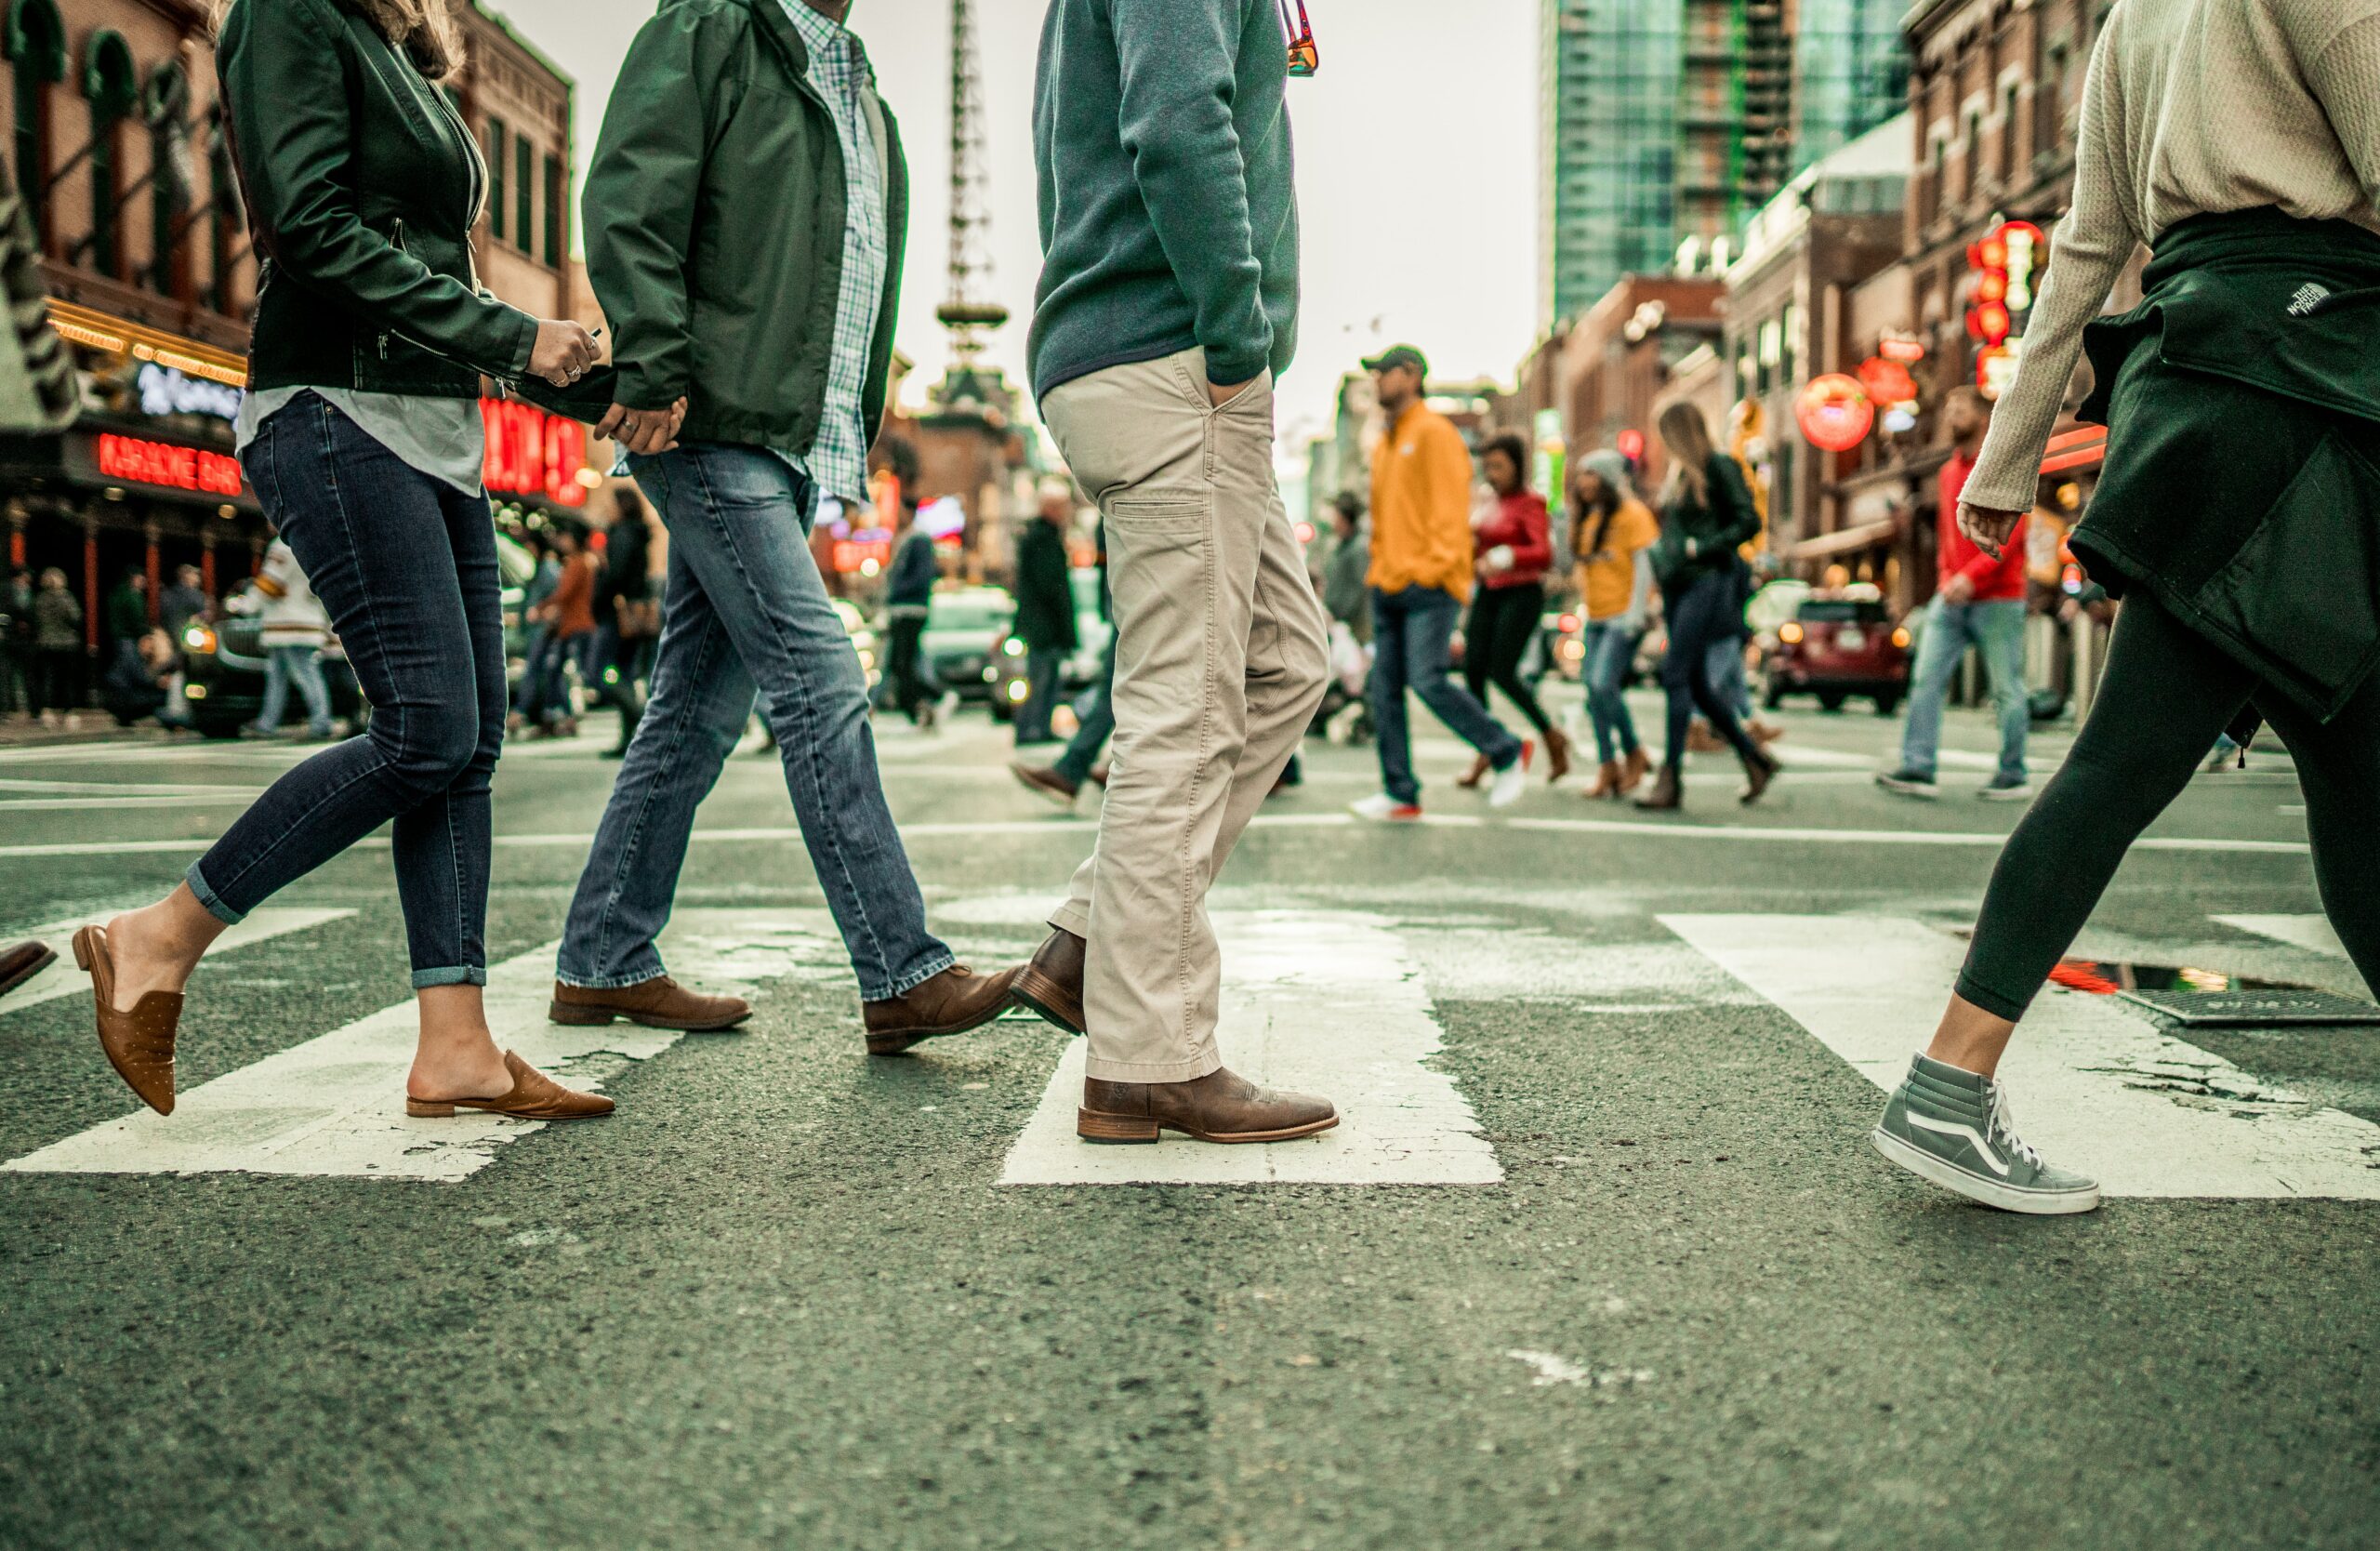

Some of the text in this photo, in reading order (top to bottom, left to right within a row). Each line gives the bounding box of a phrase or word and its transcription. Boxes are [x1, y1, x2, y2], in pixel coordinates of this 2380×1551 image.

[2287, 288, 2317, 316] NORTH
[2292, 285, 2310, 298] THE
[2301, 293, 2321, 315] FACE
